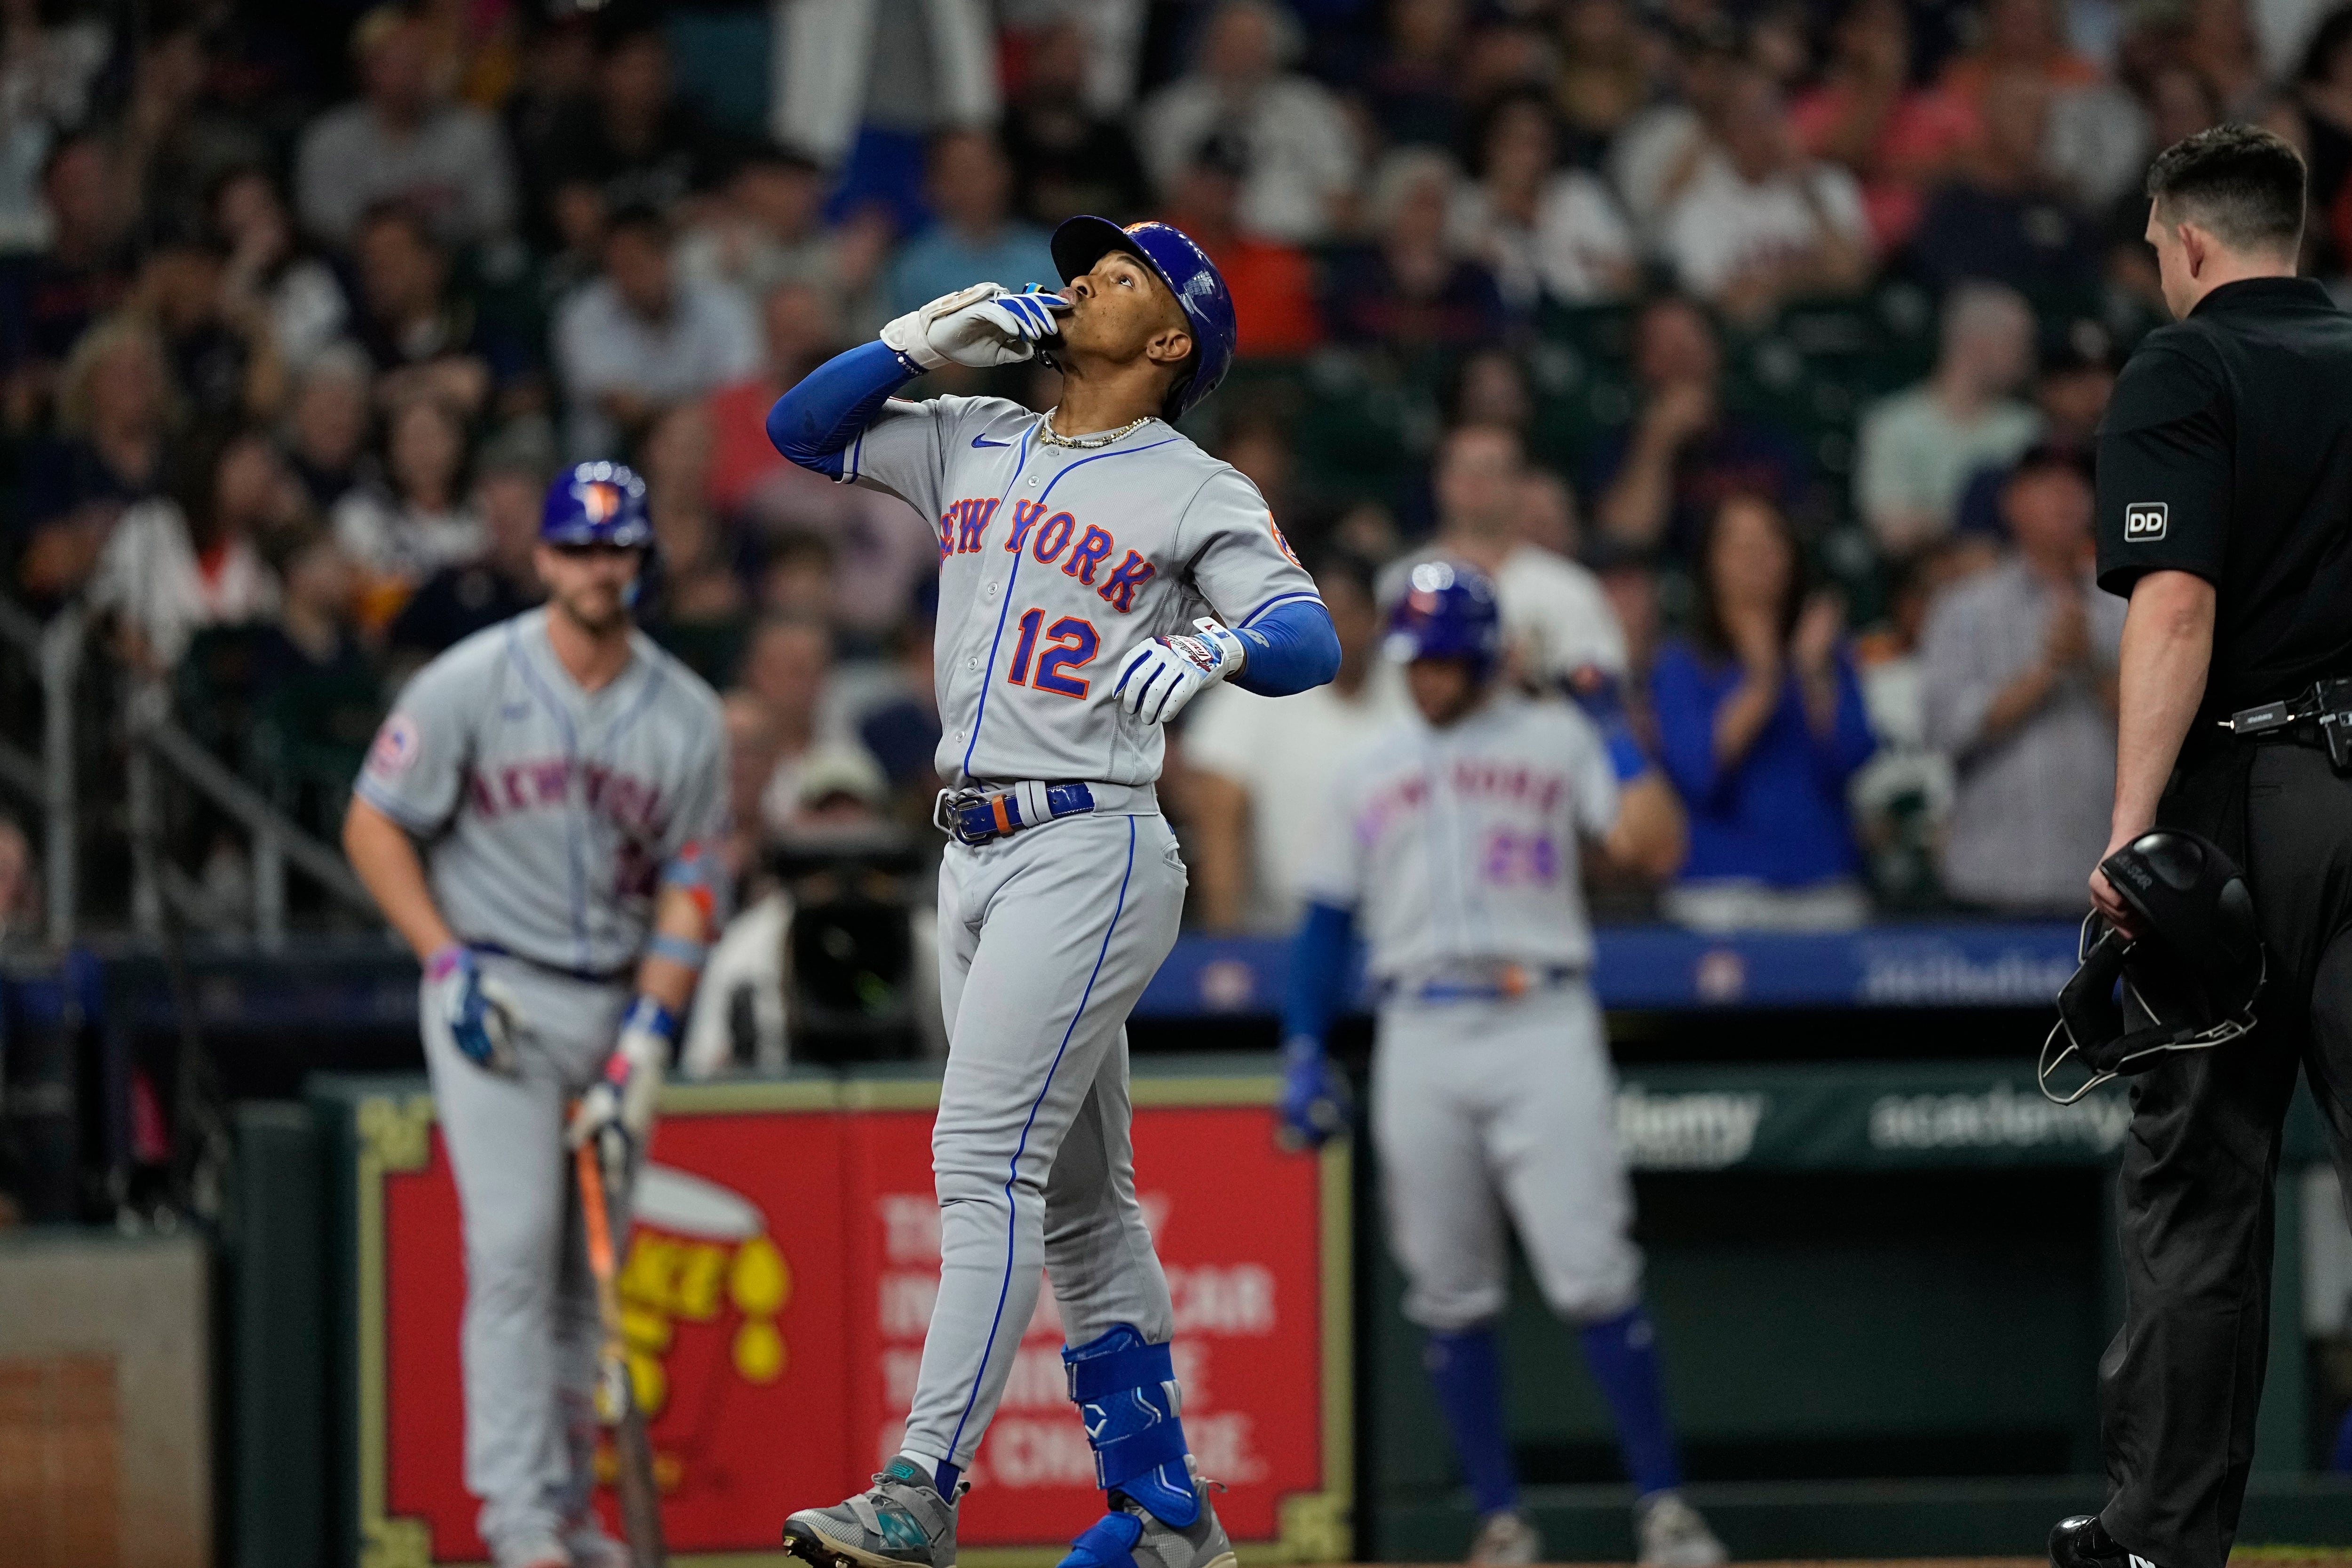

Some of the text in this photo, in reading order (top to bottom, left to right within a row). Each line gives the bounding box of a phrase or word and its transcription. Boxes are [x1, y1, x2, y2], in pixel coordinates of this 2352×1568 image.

[940, 497, 1155, 613] EW YORK
[2129, 512, 2162, 533] DD
[1008, 607, 1101, 700] 12
